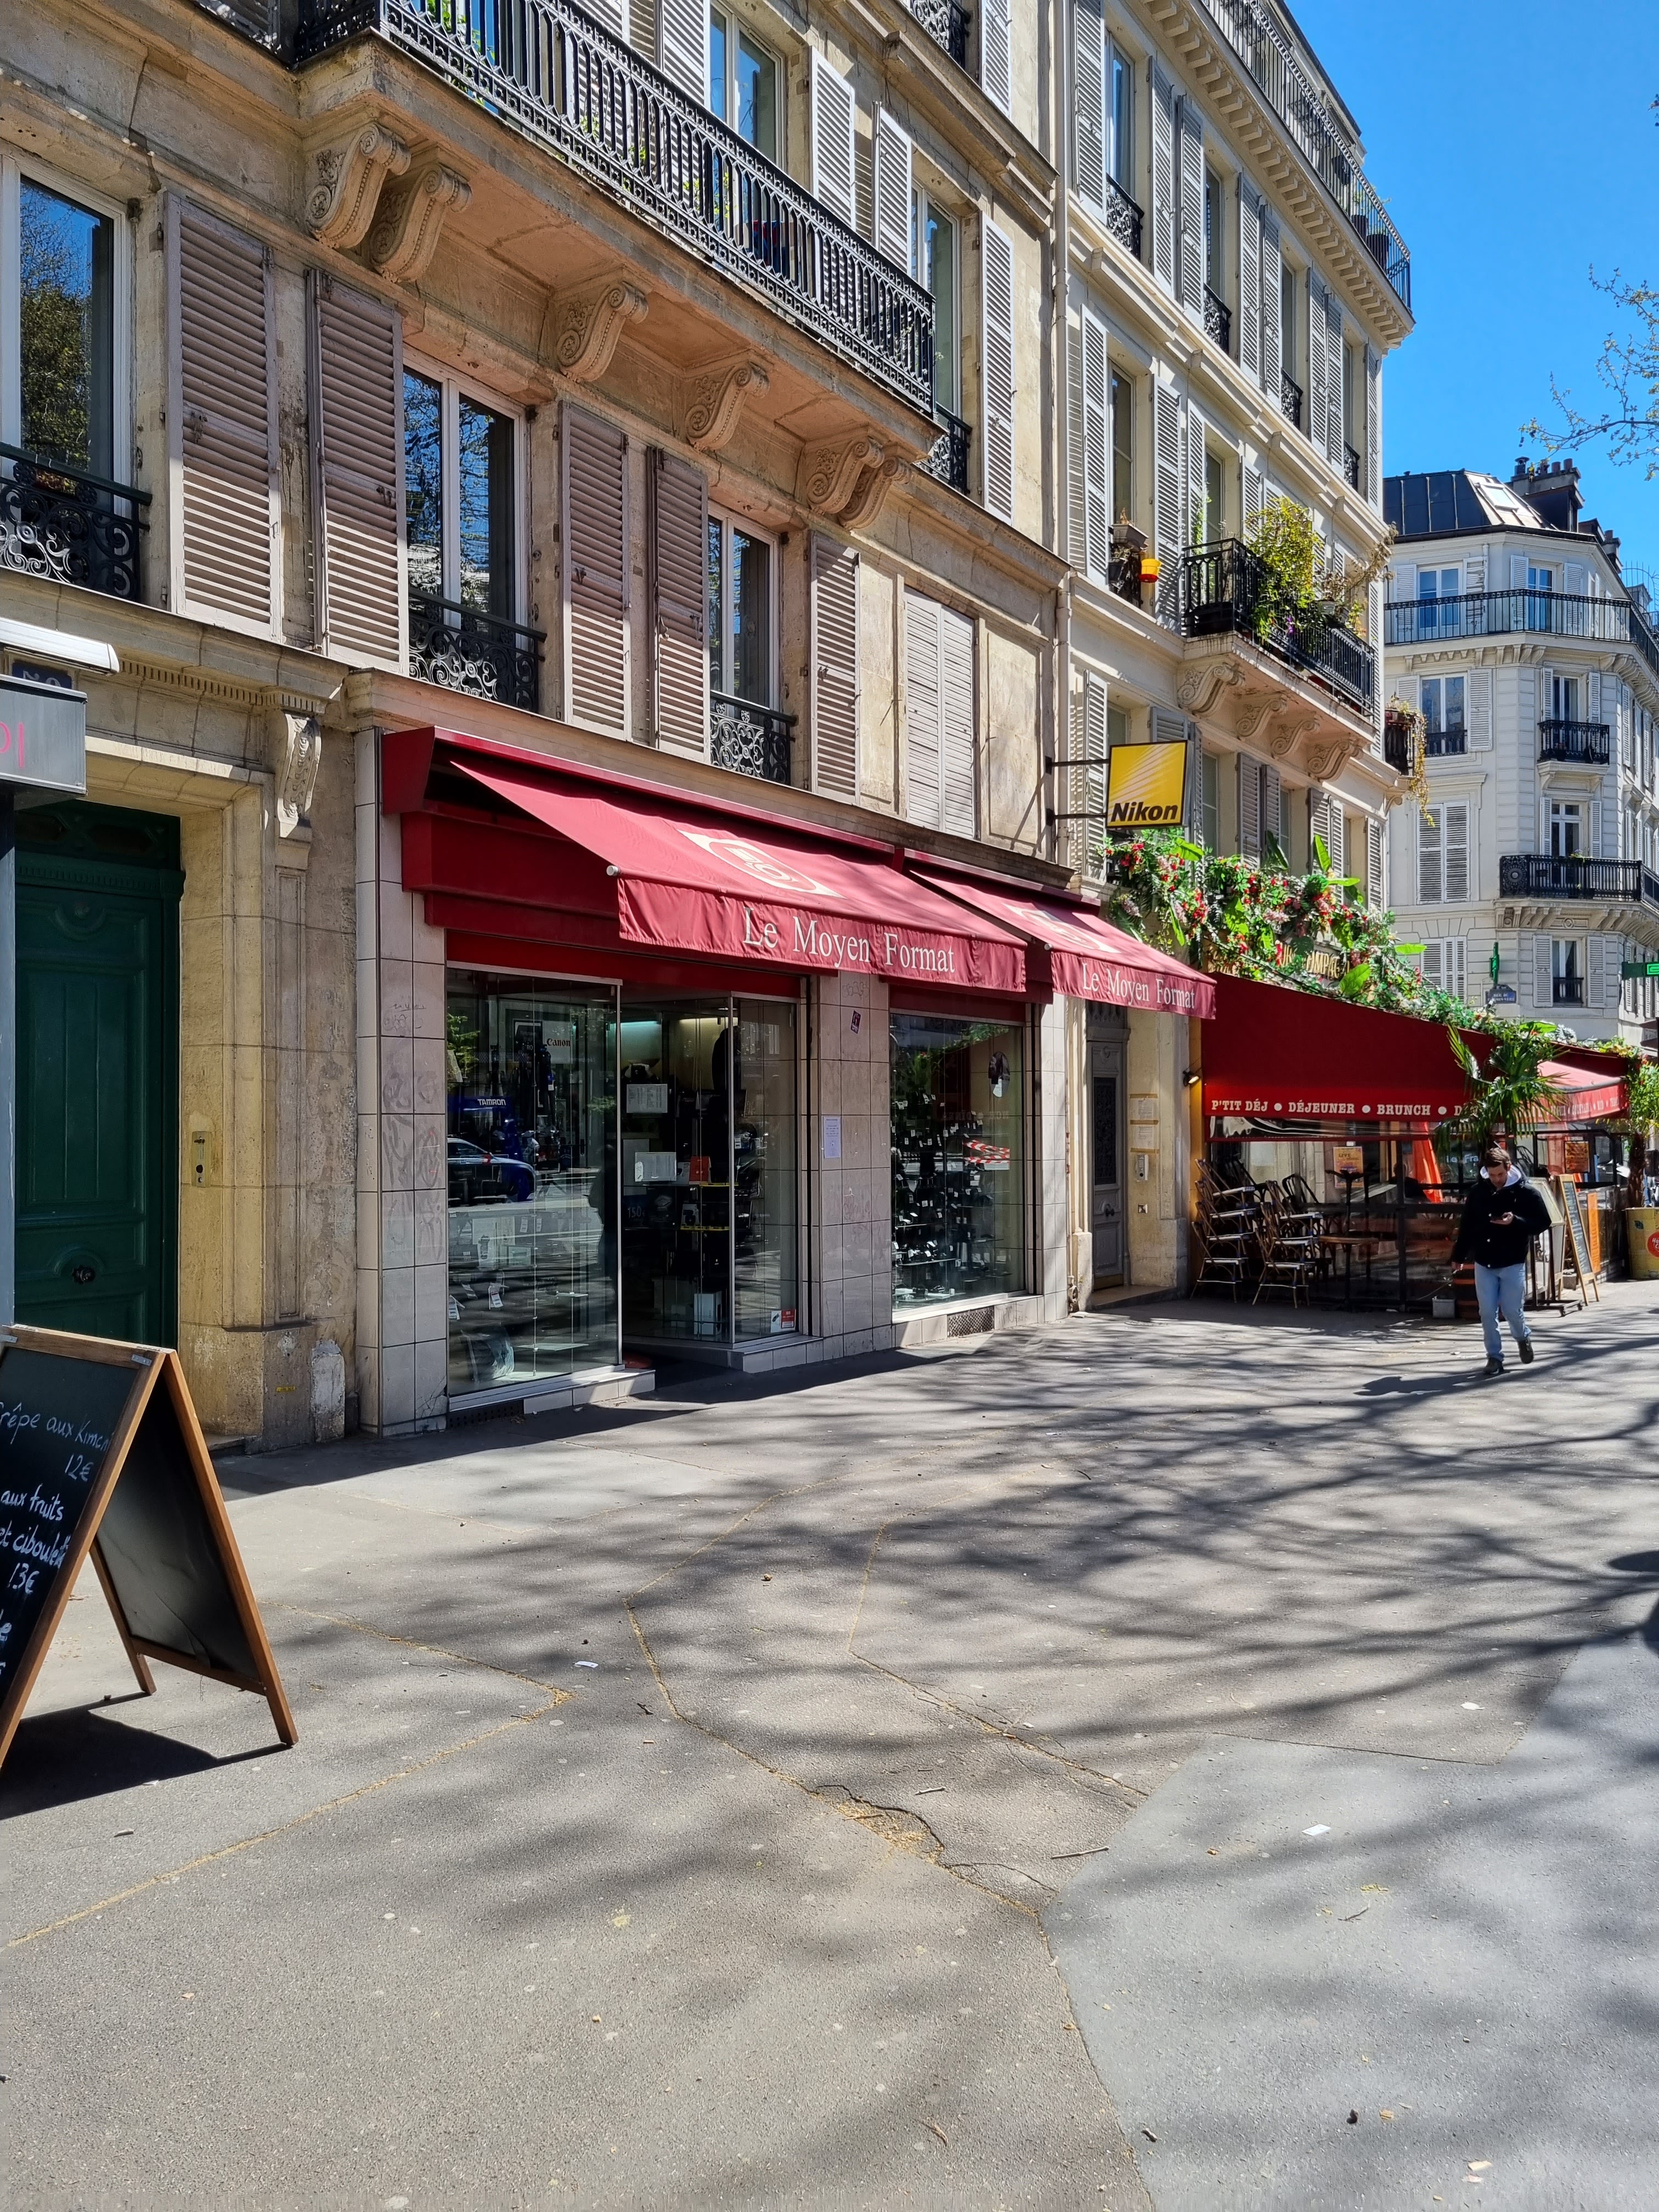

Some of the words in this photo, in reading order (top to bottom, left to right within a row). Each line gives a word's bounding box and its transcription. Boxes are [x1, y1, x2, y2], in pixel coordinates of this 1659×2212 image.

[1110, 802, 1178, 822] Nikon
[743, 906, 778, 949] Le
[792, 916, 870, 968] Moyen
[884, 932, 956, 973] Format
[1082, 962, 1099, 992] Le
[1106, 968, 1150, 1006] Moyen
[1156, 978, 1195, 1009] Format
[547, 1038, 571, 1047] Canon
[1211, 1101, 1242, 1111] P'TIT
[1245, 1098, 1268, 1112] DÉJ
[1288, 1099, 1355, 1114] DÉJEUNER
[1376, 1104, 1431, 1116] BRUNCH
[0, 1402, 41, 1444] rêpe
[47, 1417, 74, 1438] aux
[65, 1454, 94, 1482] 12€
[0, 1490, 27, 1506] aux
[29, 1483, 64, 1521] fruits
[8, 1563, 40, 1594] 13€
